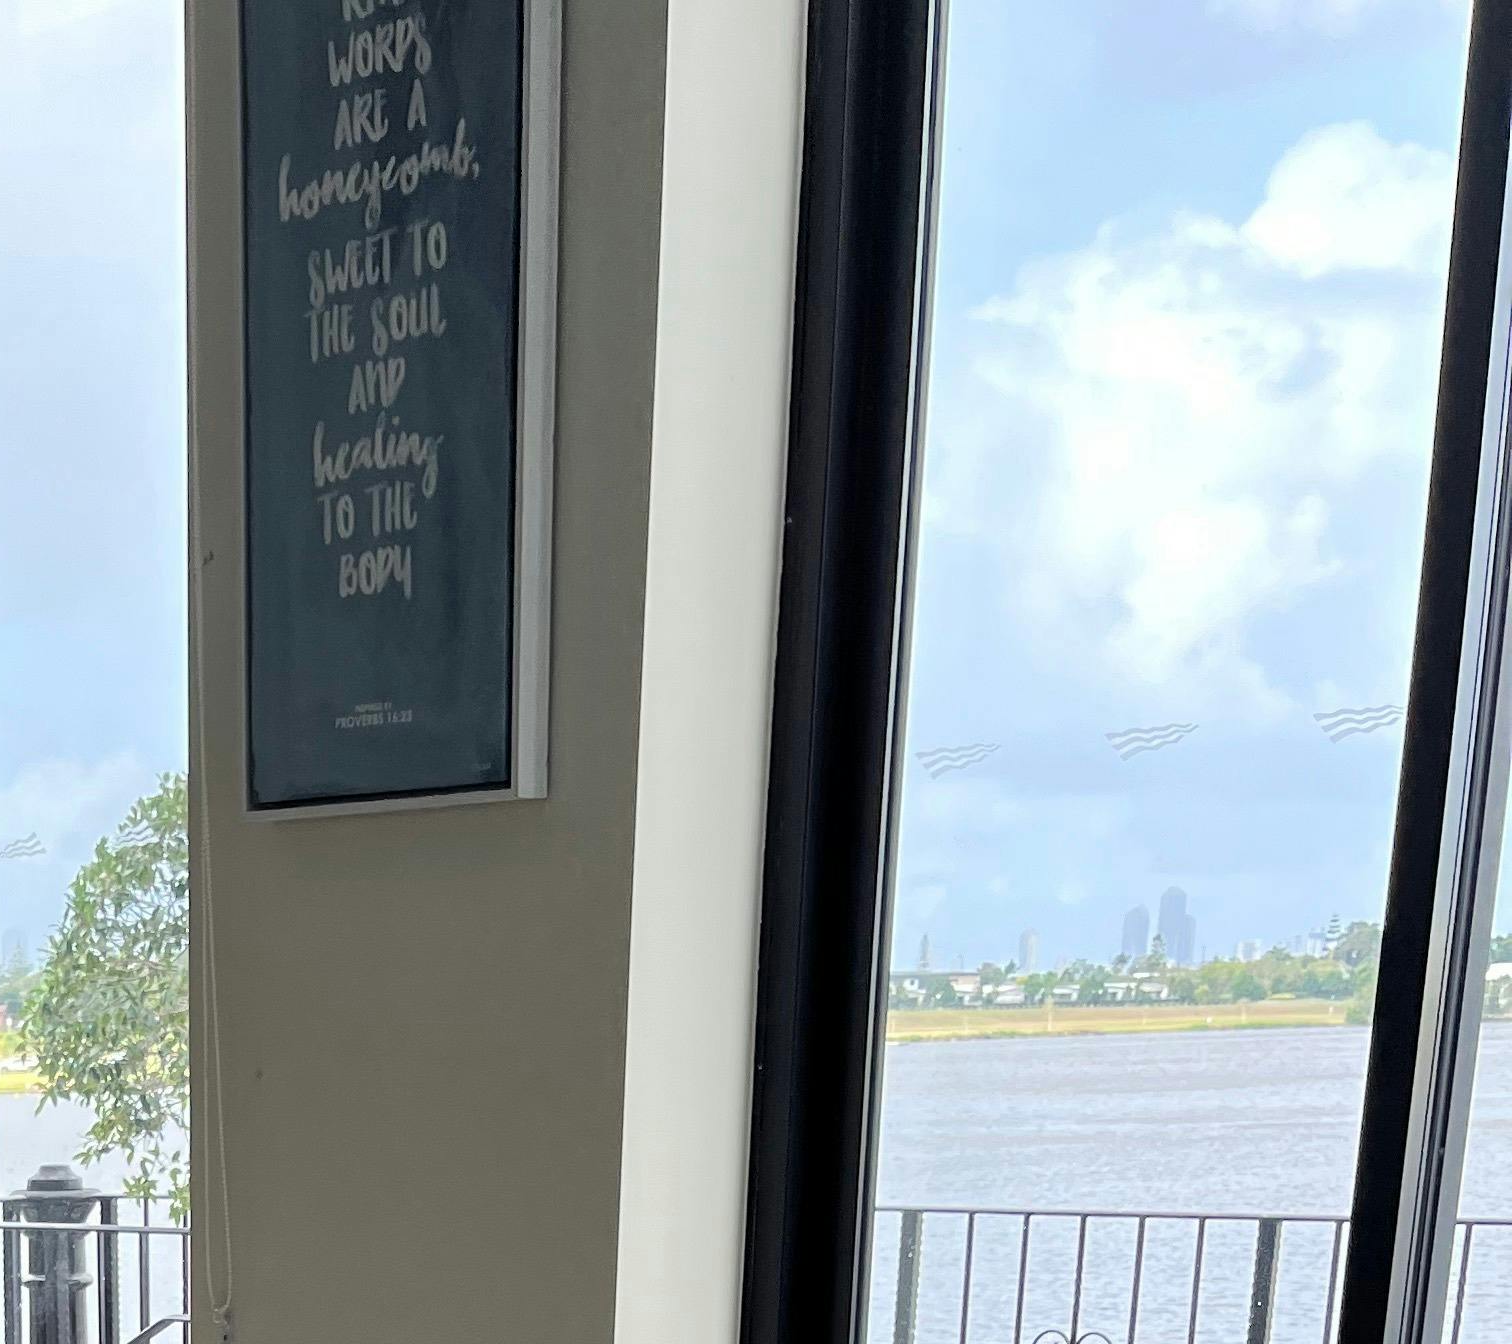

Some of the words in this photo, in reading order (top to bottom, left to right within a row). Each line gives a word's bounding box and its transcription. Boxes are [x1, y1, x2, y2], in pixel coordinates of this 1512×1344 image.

[328, 10, 432, 87] WORDS
[334, 88, 388, 150] ARE
[407, 79, 427, 131] A
[279, 117, 480, 229] honeycomb,
[308, 227, 396, 309] SWEET
[407, 220, 447, 276] TO
[304, 303, 355, 363] THE
[370, 283, 446, 356] SOUL
[348, 357, 406, 414] AND
[312, 411, 444, 498] healing
[317, 493, 355, 544] TO
[365, 480, 418, 536] THE
[339, 544, 412, 599] BODY
[335, 711, 384, 729] PROVERBS
